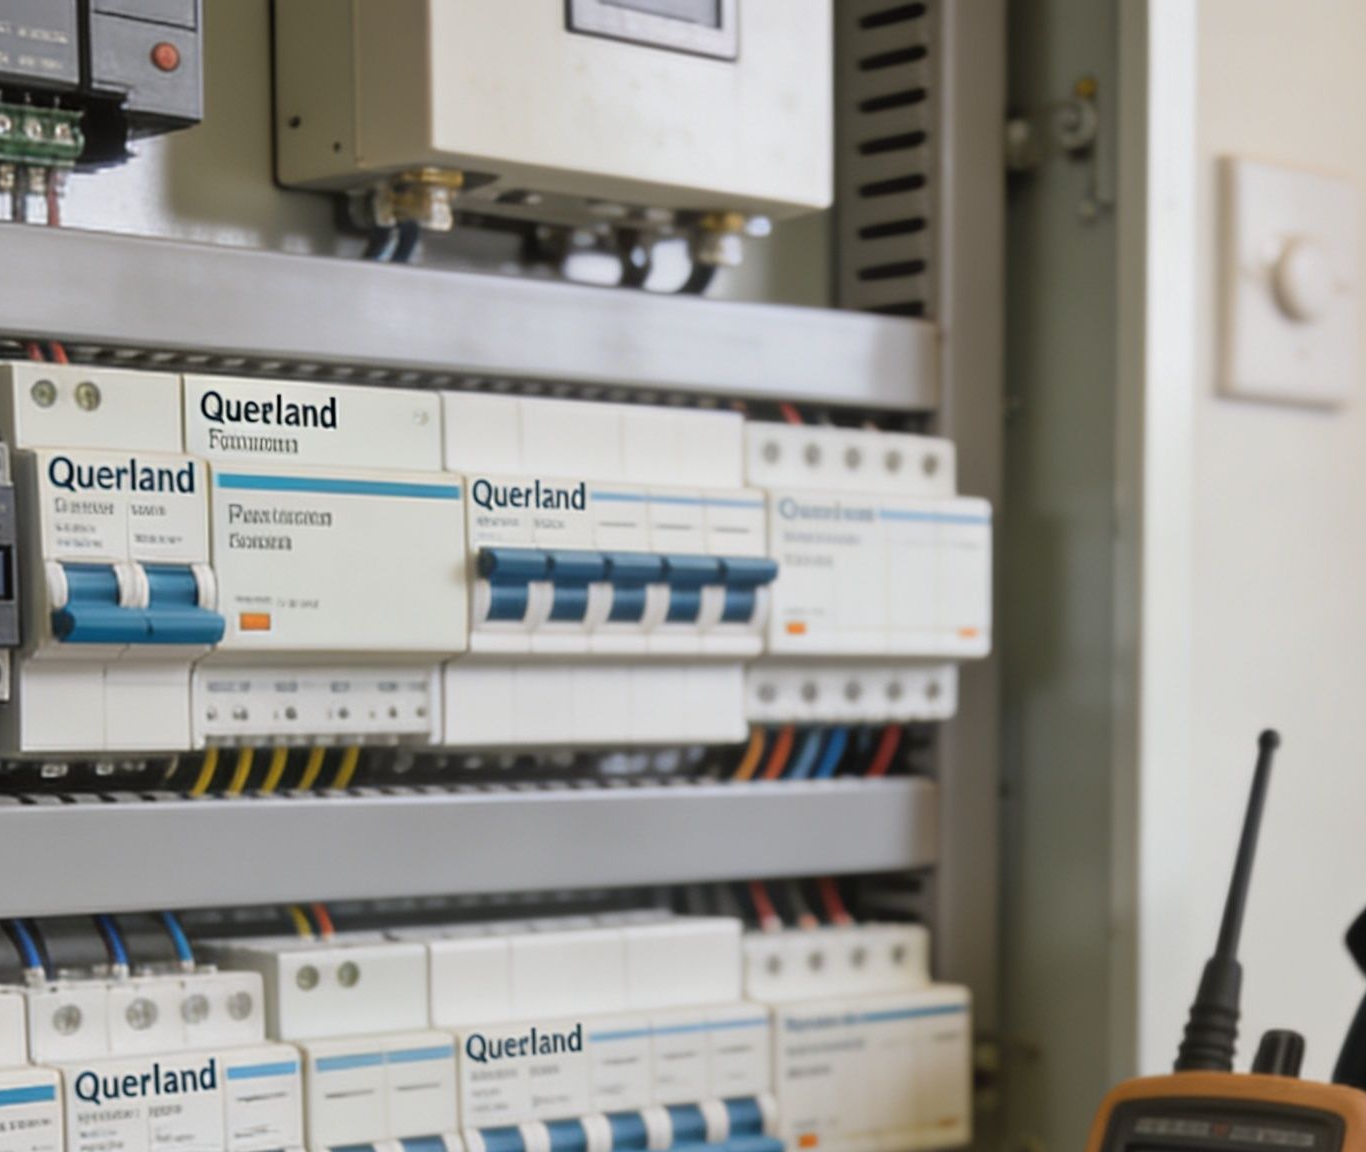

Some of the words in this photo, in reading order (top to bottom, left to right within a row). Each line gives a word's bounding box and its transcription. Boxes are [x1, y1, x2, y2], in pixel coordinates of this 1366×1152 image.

[48, 456, 195, 494] Querland
[471, 478, 586, 512] Querland
[465, 1023, 583, 1063] Querland
[75, 1058, 217, 1105] Querland
